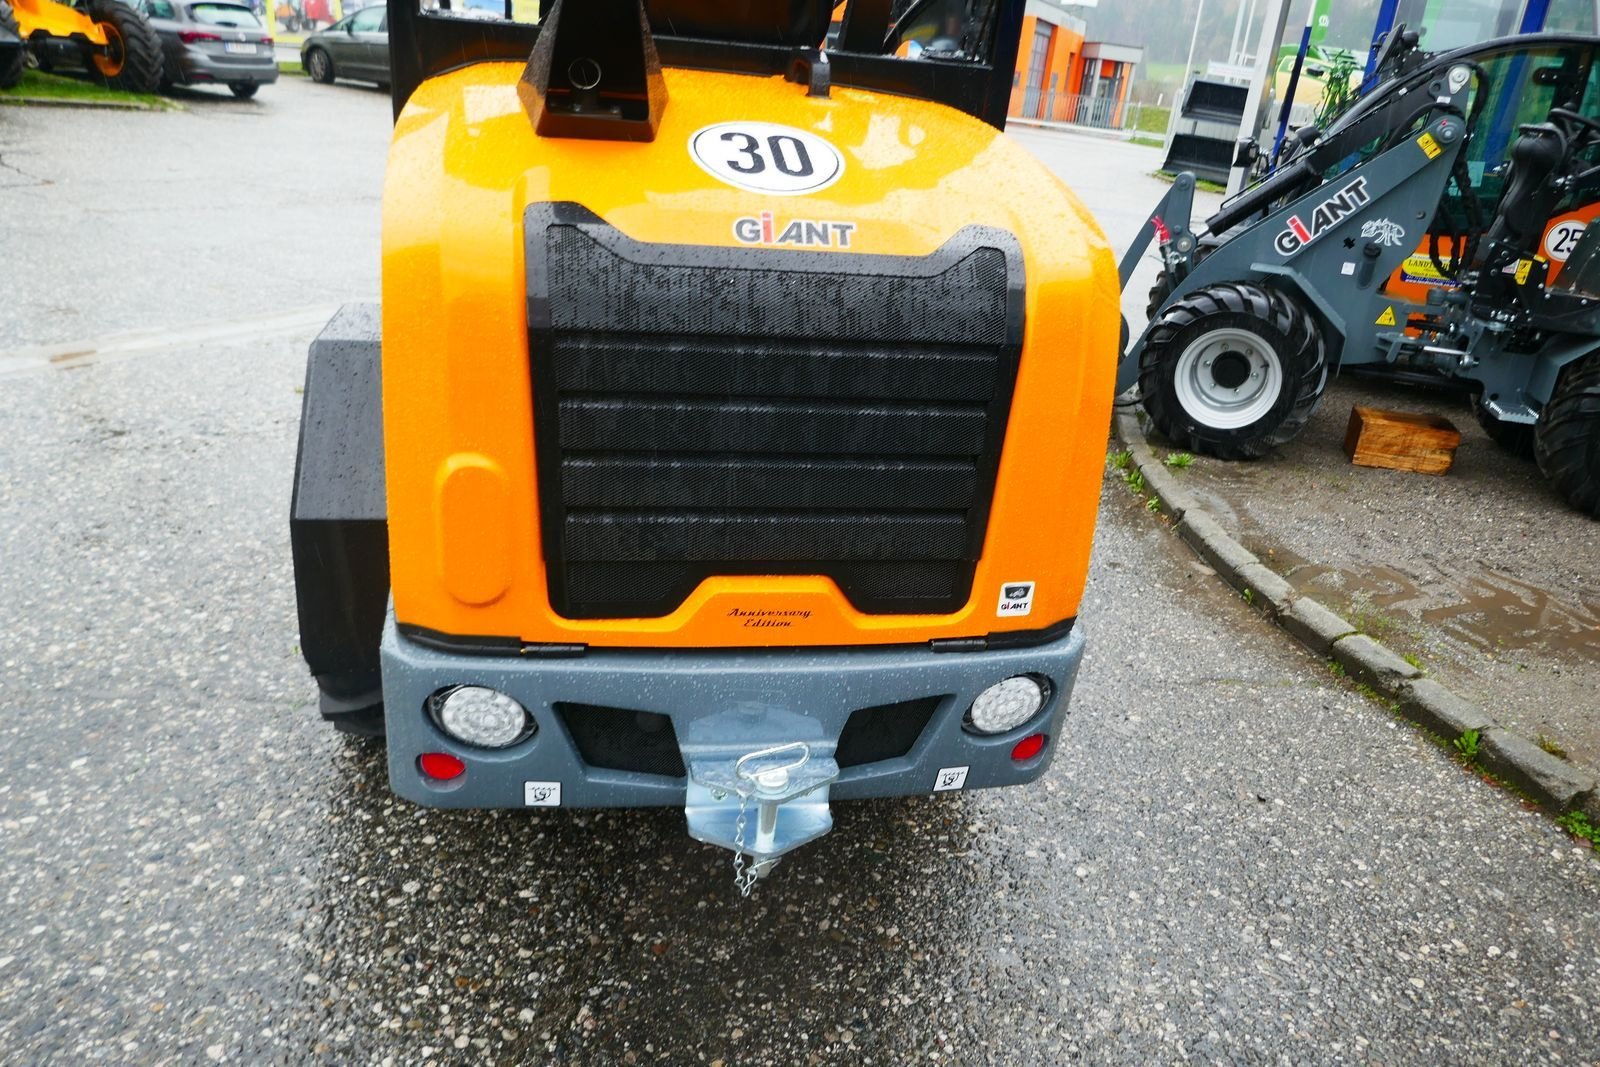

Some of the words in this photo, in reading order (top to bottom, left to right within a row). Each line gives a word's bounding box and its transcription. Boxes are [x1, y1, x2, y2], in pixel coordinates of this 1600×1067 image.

[720, 132, 814, 178] 30
[1552, 227, 1584, 253] 25
[727, 608, 813, 619] Anniversary
[743, 619, 794, 627] Edition
